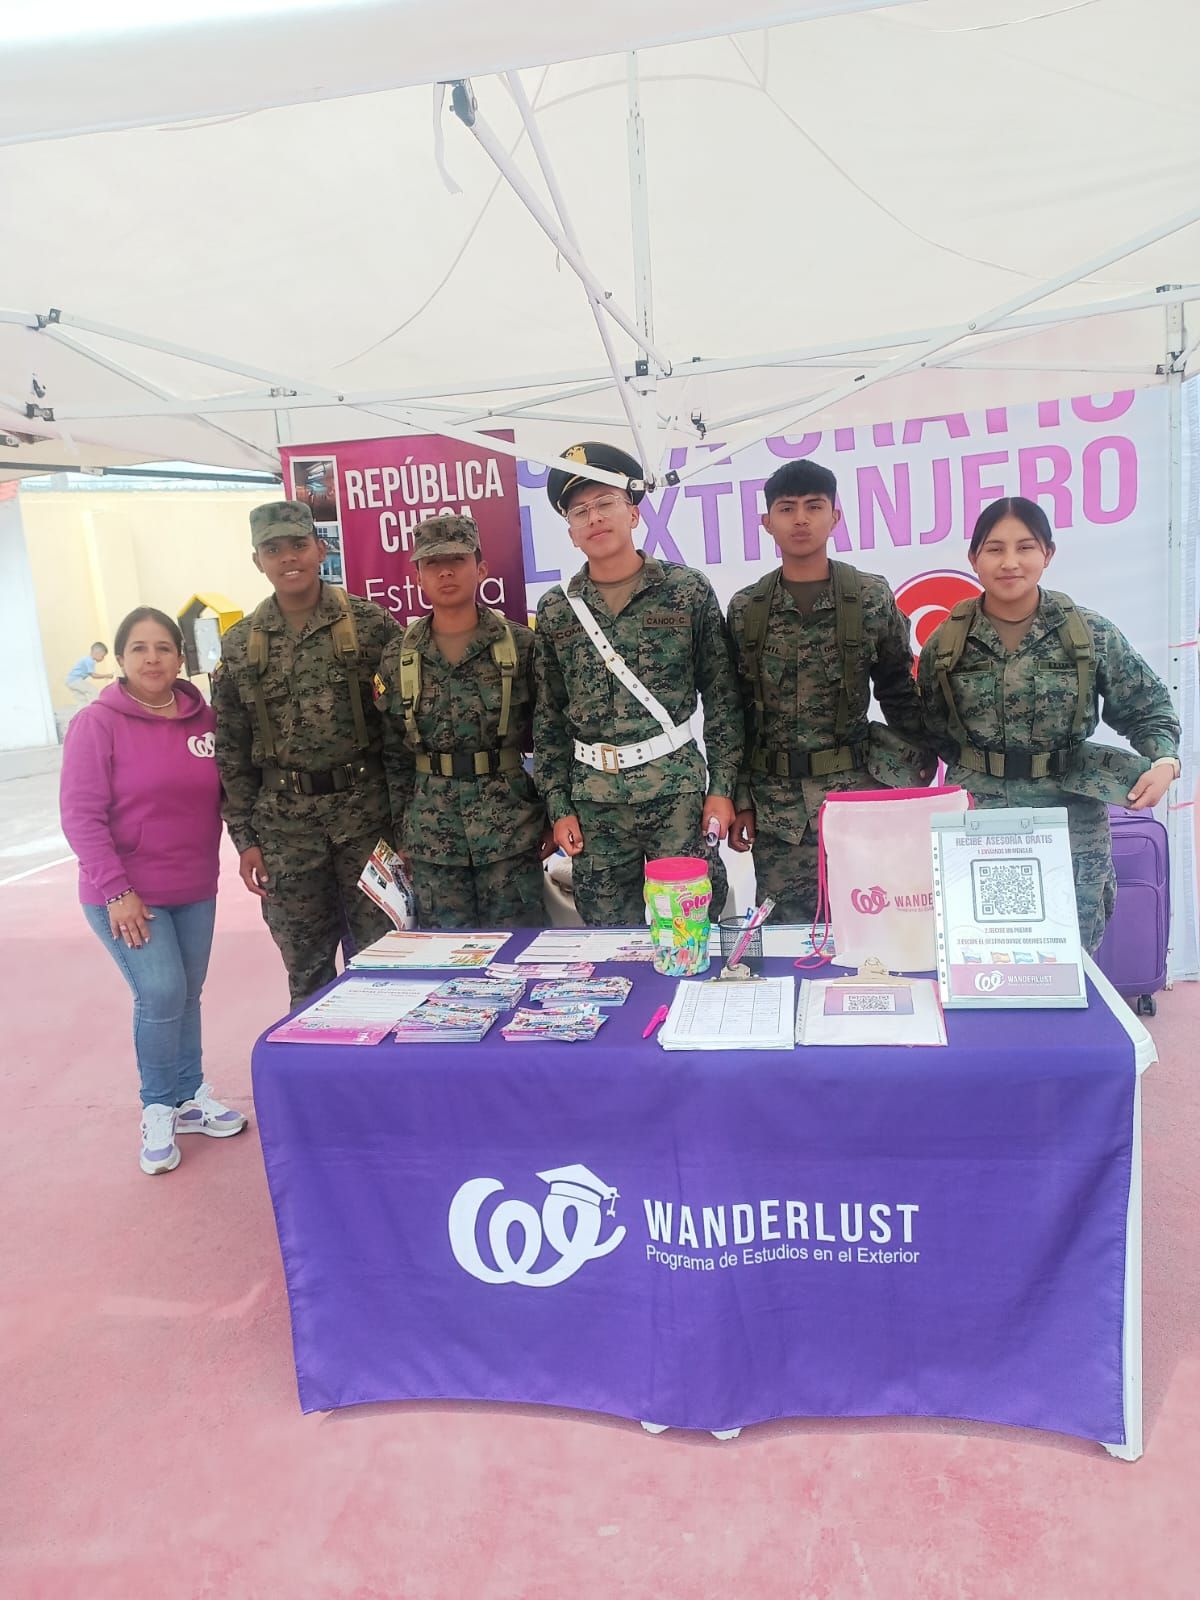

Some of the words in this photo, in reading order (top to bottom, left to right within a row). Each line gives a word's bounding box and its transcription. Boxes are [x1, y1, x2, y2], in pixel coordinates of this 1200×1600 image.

[344, 456, 504, 510] REPÚBLICA
[955, 837, 982, 846] RECIBE
[1025, 835, 1053, 844] GRATIS
[894, 892, 934, 907] WANDE
[1007, 975, 1052, 985] WANDERLUST
[643, 1199, 919, 1248] WANDERLUST
[646, 1244, 714, 1271] Programa
[720, 1251, 738, 1268] de
[743, 1243, 808, 1265] Estudios
[813, 1249, 833, 1261] en
[838, 1247, 852, 1263] el
[857, 1247, 920, 1264] Exterior
